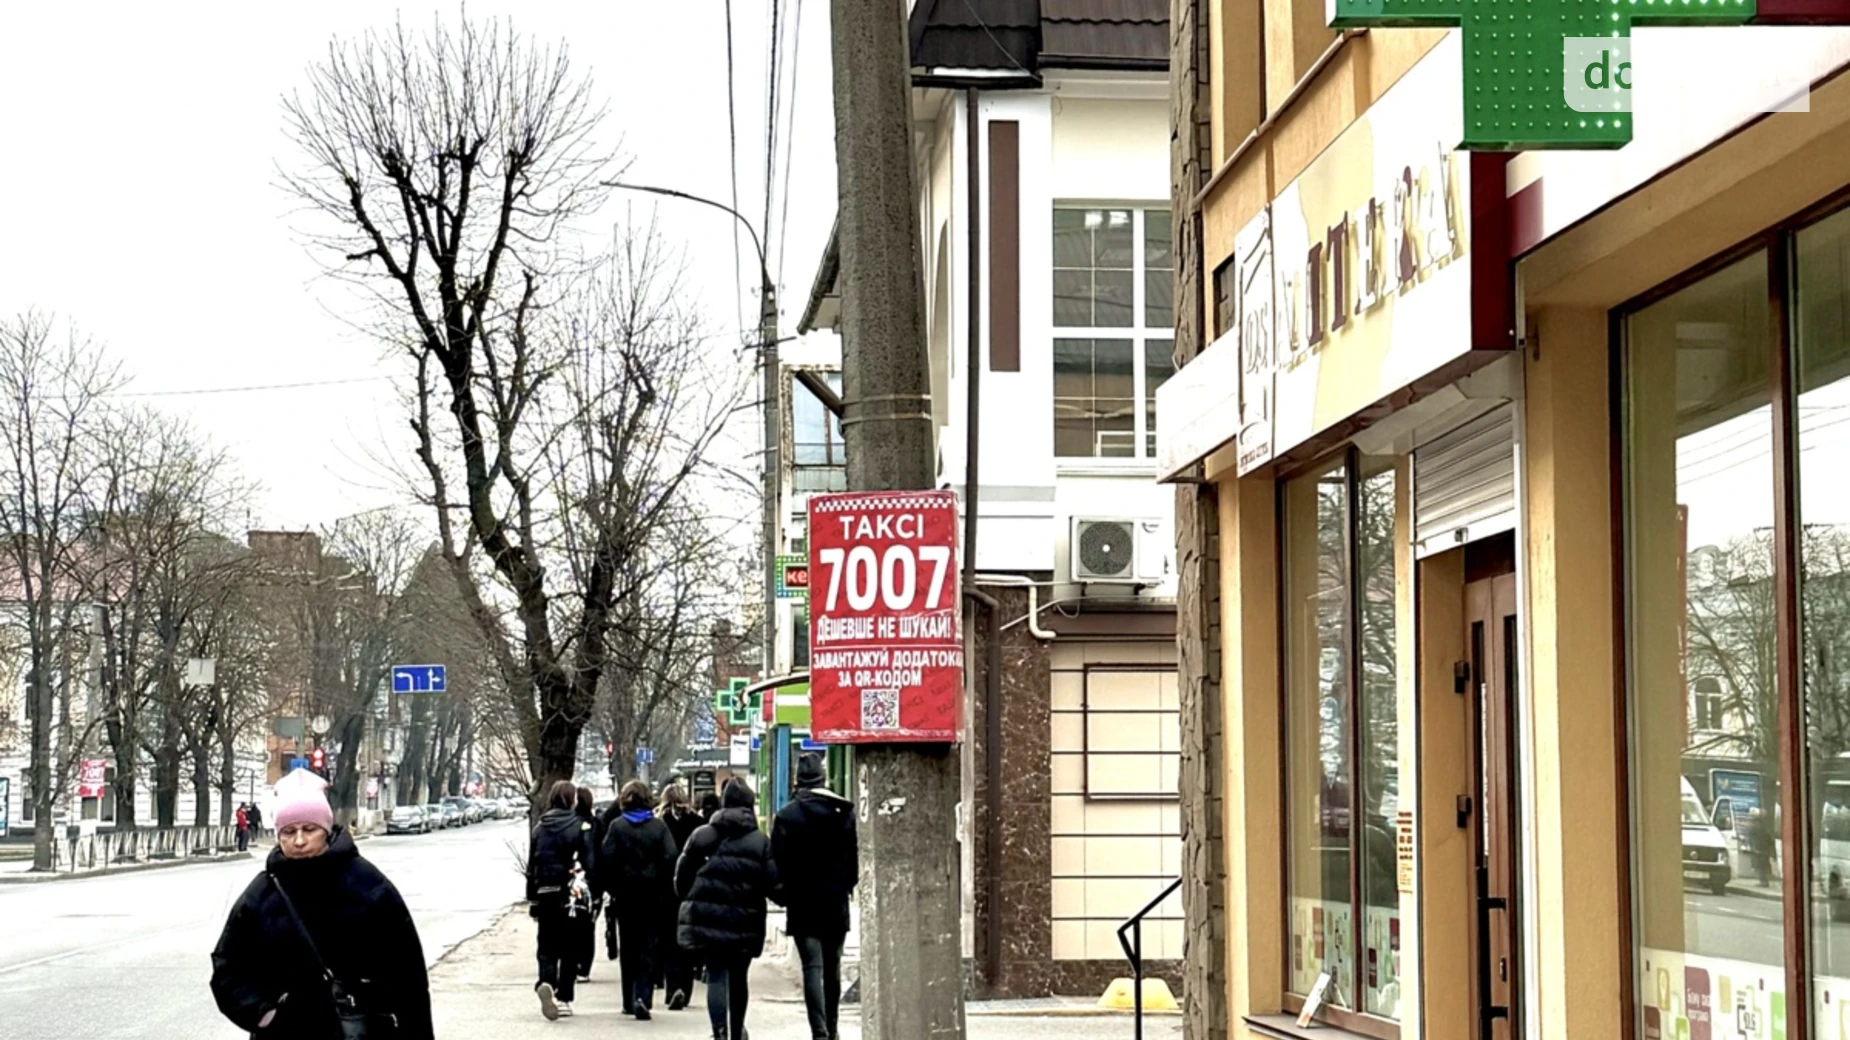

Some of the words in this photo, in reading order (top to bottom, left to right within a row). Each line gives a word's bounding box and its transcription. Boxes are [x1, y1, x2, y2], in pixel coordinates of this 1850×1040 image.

[839, 514, 924, 540] ТАКСІ
[819, 545, 951, 612] 7007
[817, 616, 874, 644] ДЕШЕВШЕ
[877, 616, 896, 639] НЕ
[898, 614, 951, 640] ШУКАЙ!
[813, 648, 889, 670] ЗАВАНТАЖУЙ
[892, 649, 957, 671] ДОДАТОК
[838, 671, 852, 687] ЗА
[854, 669, 922, 689] QR-КОДОМ
